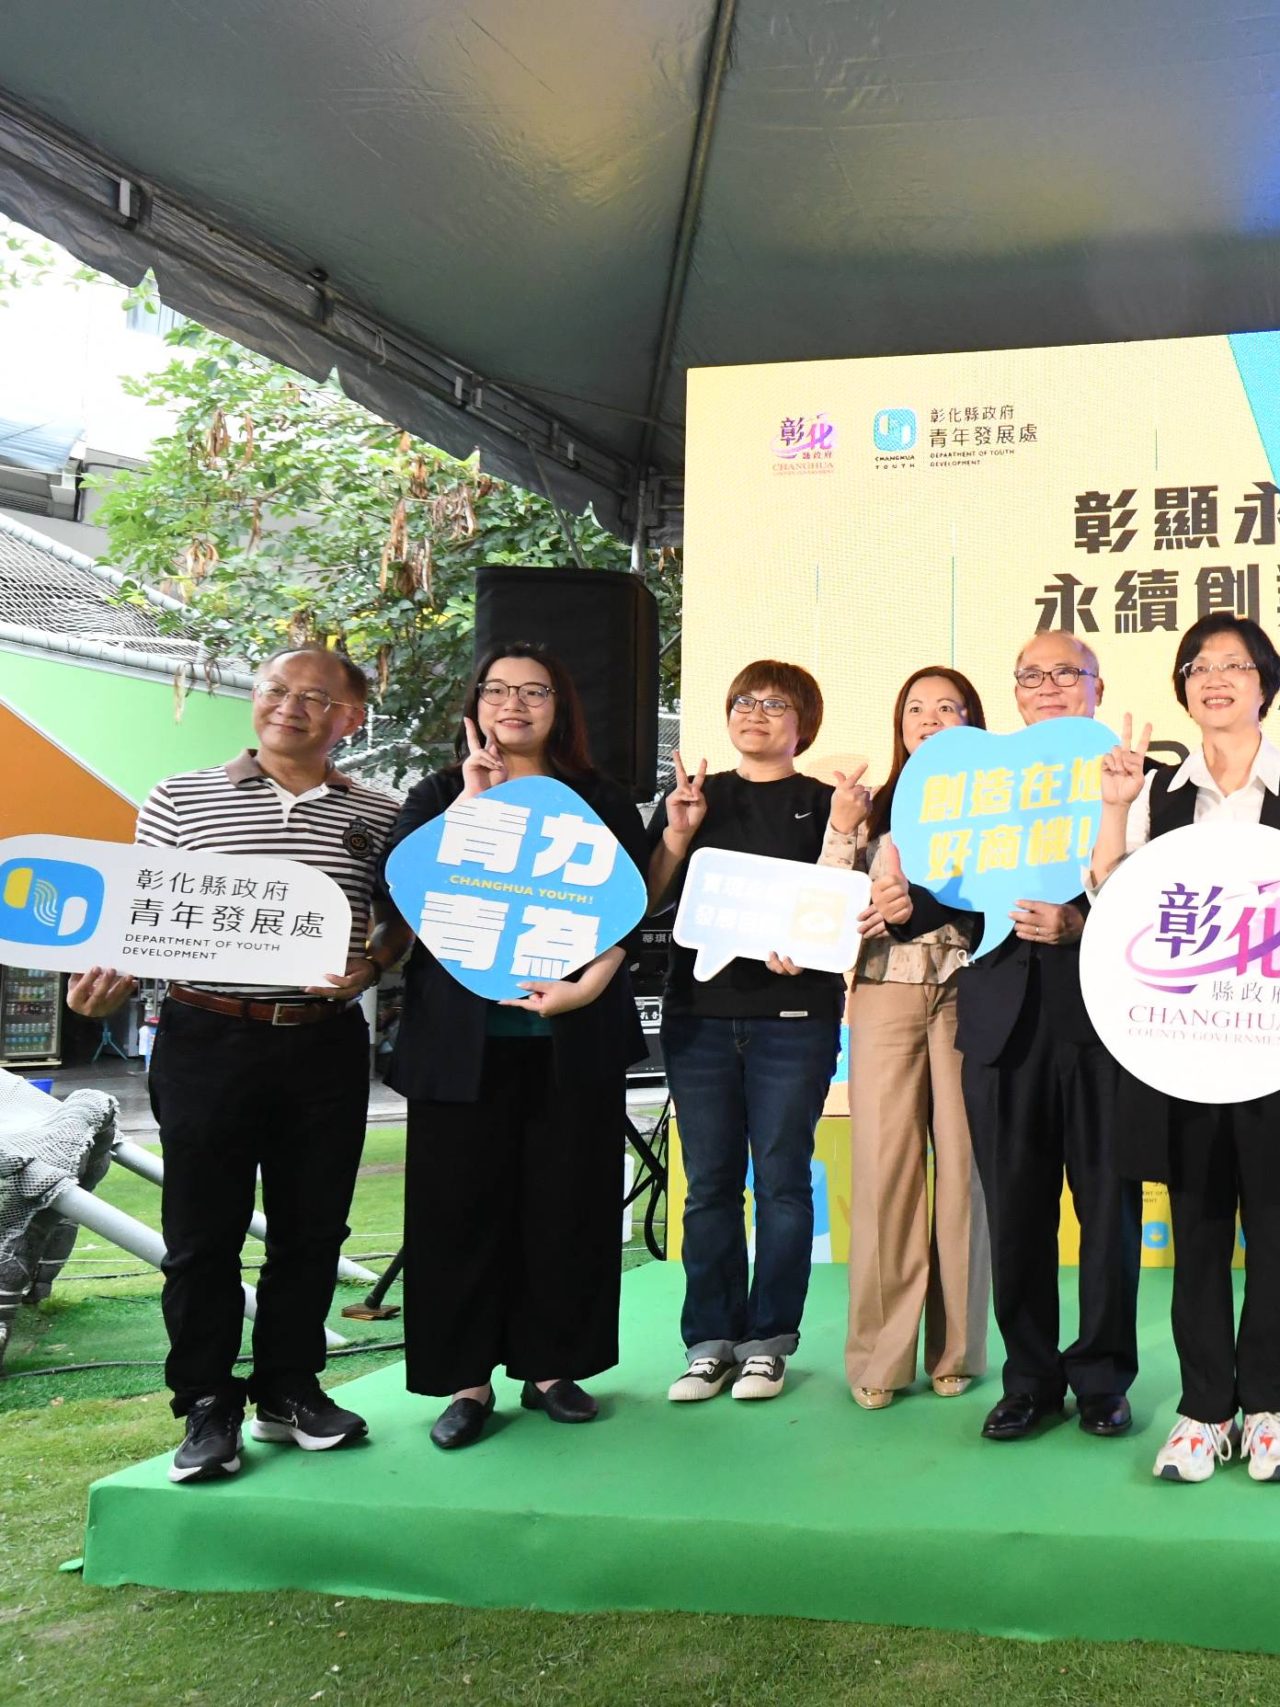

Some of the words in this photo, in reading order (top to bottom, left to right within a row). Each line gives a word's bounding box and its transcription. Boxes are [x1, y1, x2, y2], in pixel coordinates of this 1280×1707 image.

[931, 404, 1015, 423] 彰化縣政府
[929, 423, 1038, 448] 青年發展處
[930, 450, 976, 459] DEPARTMENT
[978, 449, 988, 457] OF
[930, 459, 981, 467] DEVELOPMENT
[436, 797, 619, 887] 青力
[136, 868, 290, 901] 彰化縣政府
[449, 874, 534, 896] CHANGHUA
[538, 888, 594, 905] YOUTH!
[130, 898, 325, 938] 青年發展處
[125, 933, 211, 947] DEPARTMENT
[215, 940, 233, 948] OF
[237, 943, 281, 952] YOUTH
[122, 946, 217, 960] DEVELOPMENT
[1128, 1027, 1187, 1041] COUNTY
